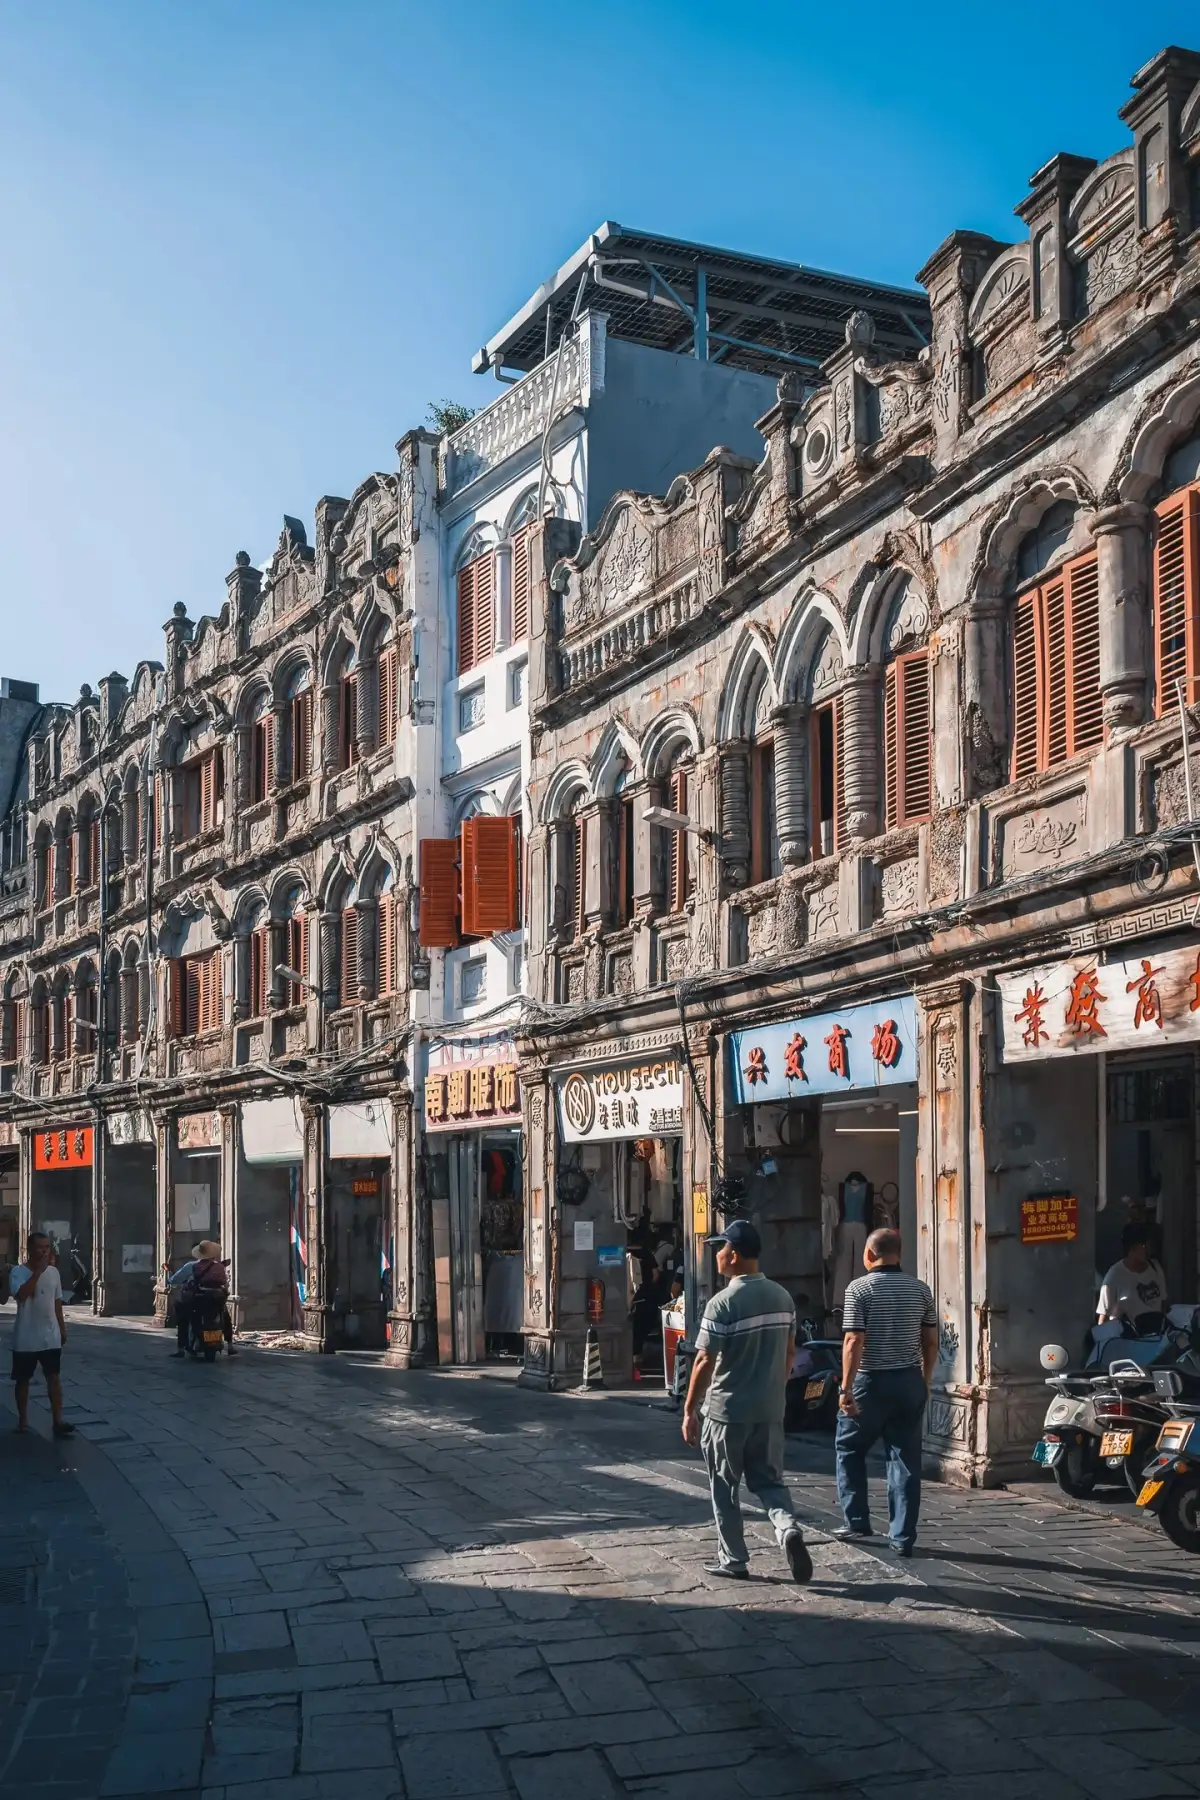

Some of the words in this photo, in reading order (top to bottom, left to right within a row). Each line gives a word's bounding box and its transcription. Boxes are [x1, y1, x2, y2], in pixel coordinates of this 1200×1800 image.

[1014, 952, 1200, 1048] 業發商
[743, 1019, 902, 1085] 兴发商场
[1028, 1211, 1068, 1225] 业发商场
